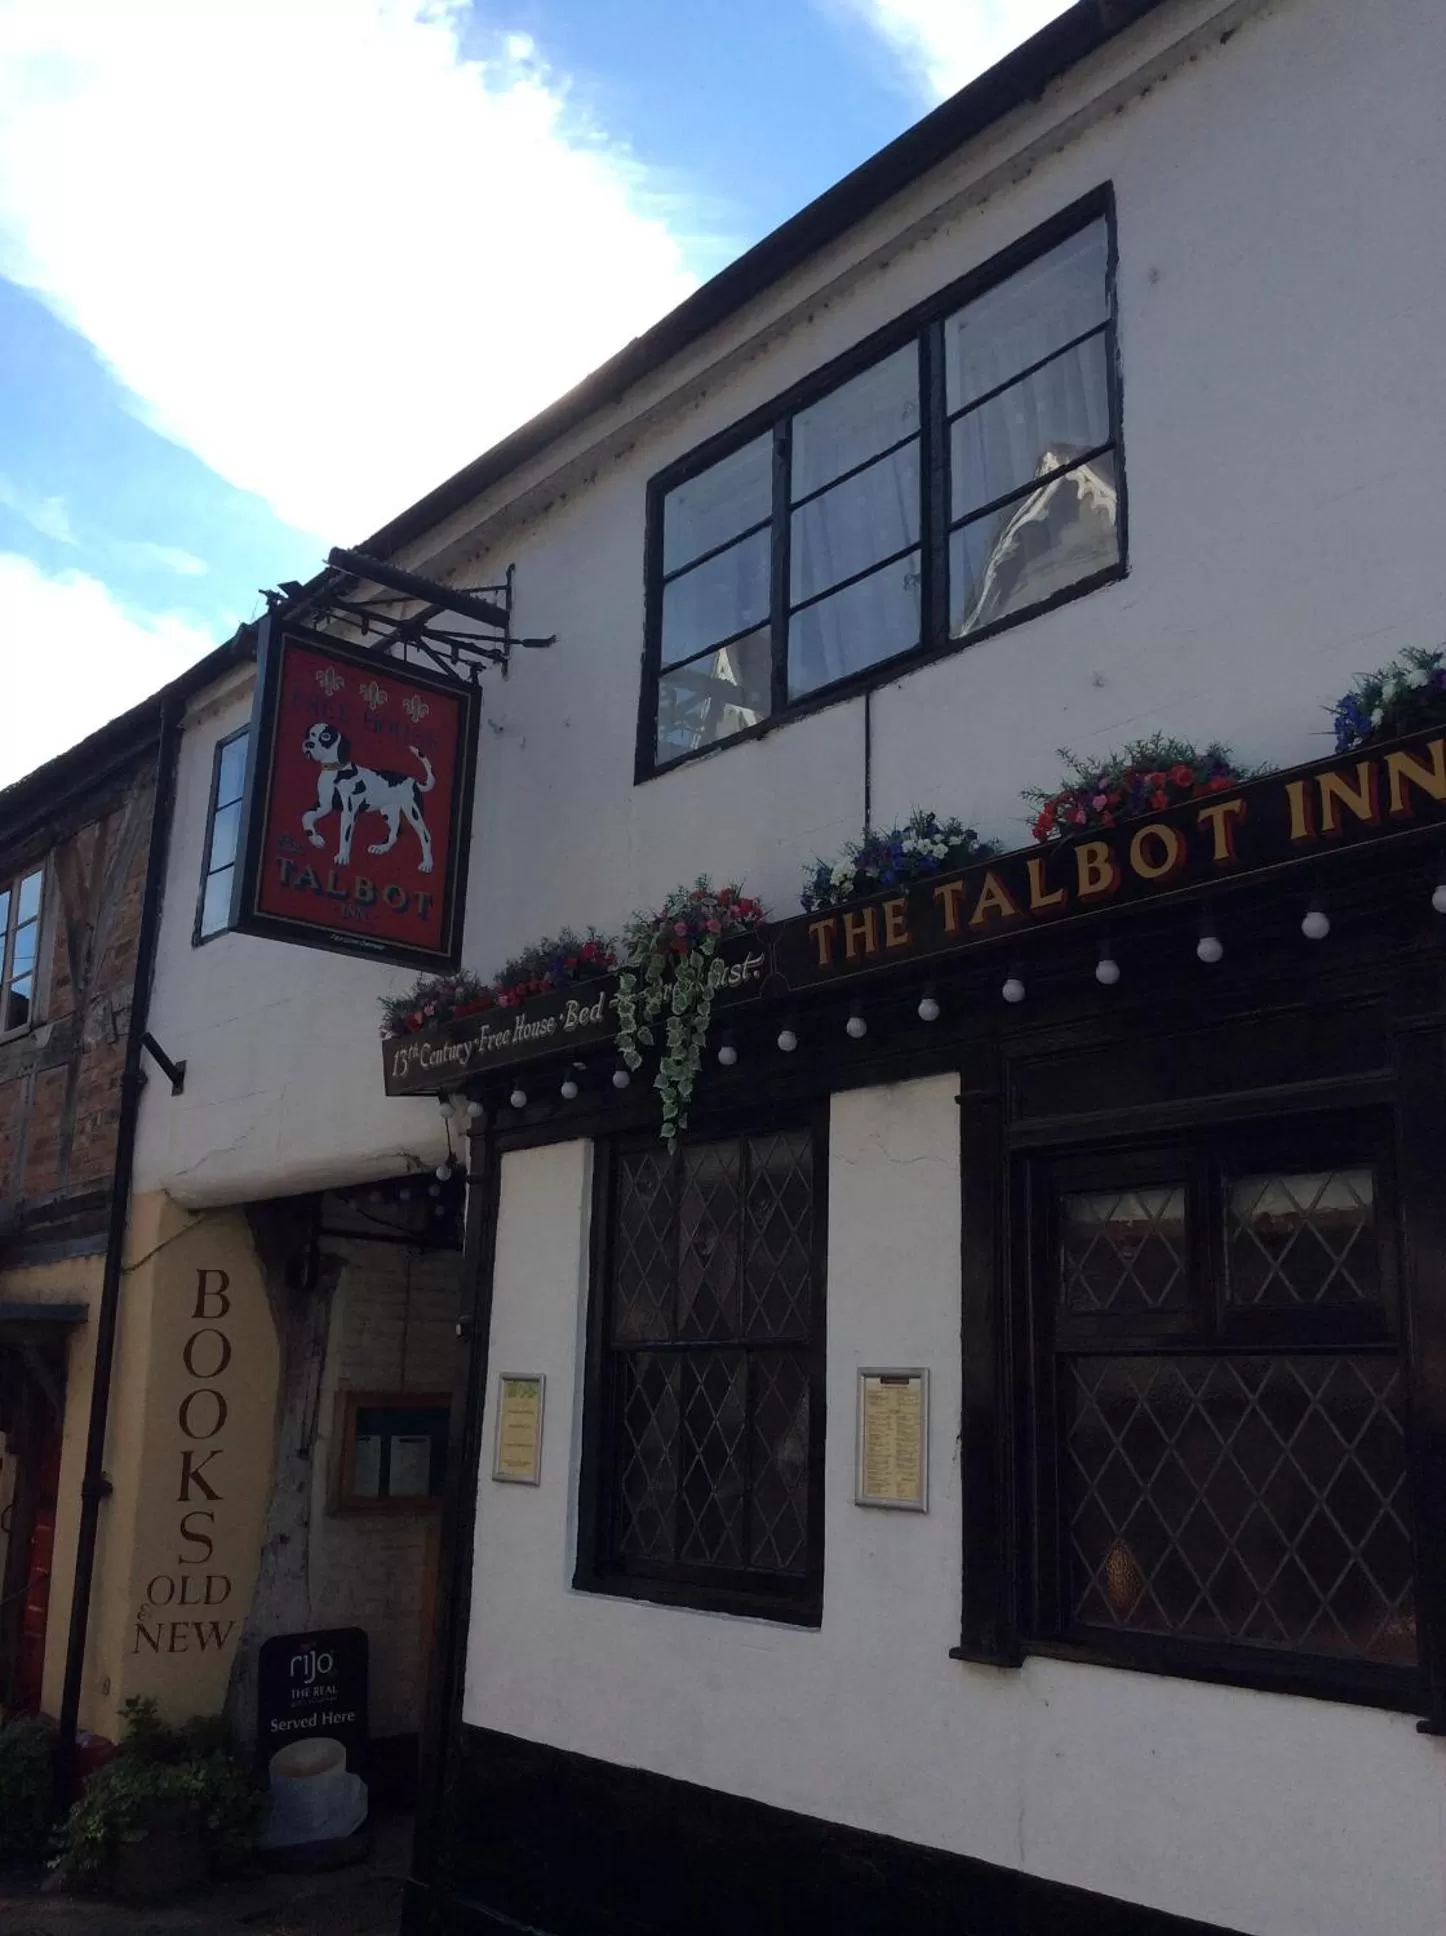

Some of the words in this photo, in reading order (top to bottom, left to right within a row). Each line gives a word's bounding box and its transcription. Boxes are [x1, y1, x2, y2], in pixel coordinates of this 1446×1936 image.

[807, 898, 909, 966] THE
[932, 799, 1245, 934] TALBOT
[1285, 736, 1446, 842] INN
[275, 856, 434, 919] TALBOT
[391, 1042, 420, 1077] 13th
[418, 1039, 473, 1070] Century
[478, 1024, 512, 1053] Free
[512, 1012, 556, 1044] House
[563, 991, 605, 1032] Bed
[175, 1268, 232, 1566] BOOKS
[146, 1574, 232, 1607] OLD
[132, 1621, 236, 1655] NEW
[270, 1711, 317, 1732] Served
[321, 1709, 357, 1727] Here
